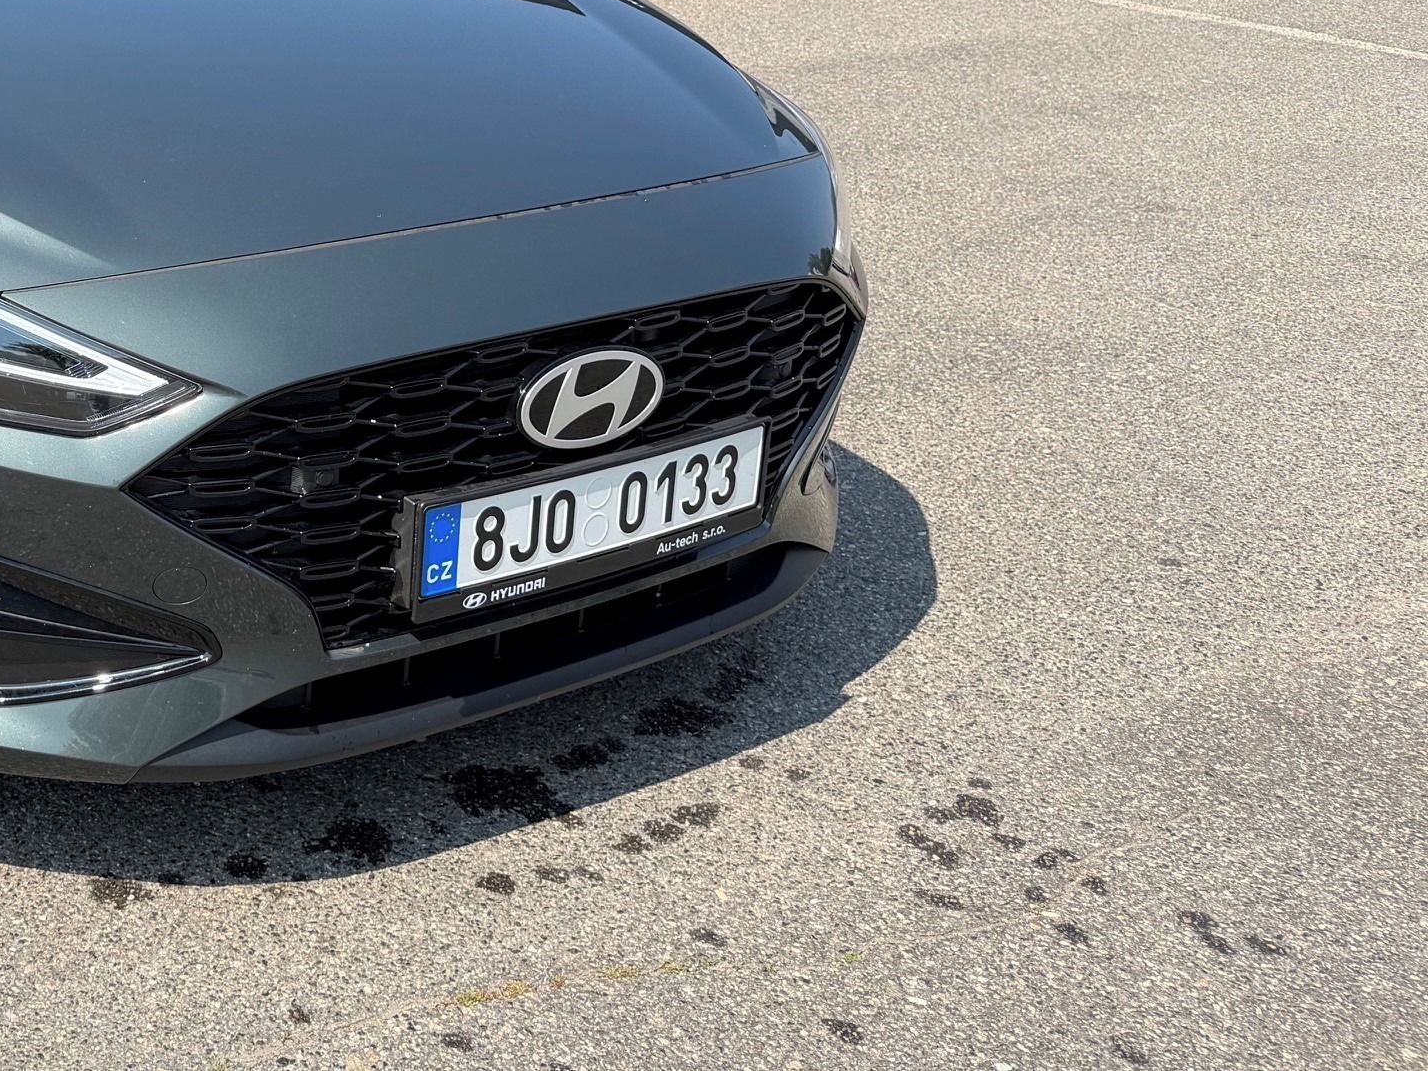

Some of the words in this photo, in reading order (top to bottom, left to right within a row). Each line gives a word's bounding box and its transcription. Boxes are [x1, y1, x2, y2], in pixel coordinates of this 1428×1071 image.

[619, 444, 739, 534] 0133
[656, 531, 698, 555] Au-tech
[702, 525, 726, 540] s.r.o.
[426, 560, 452, 584] CZ
[490, 577, 546, 602] HYUNDAI
